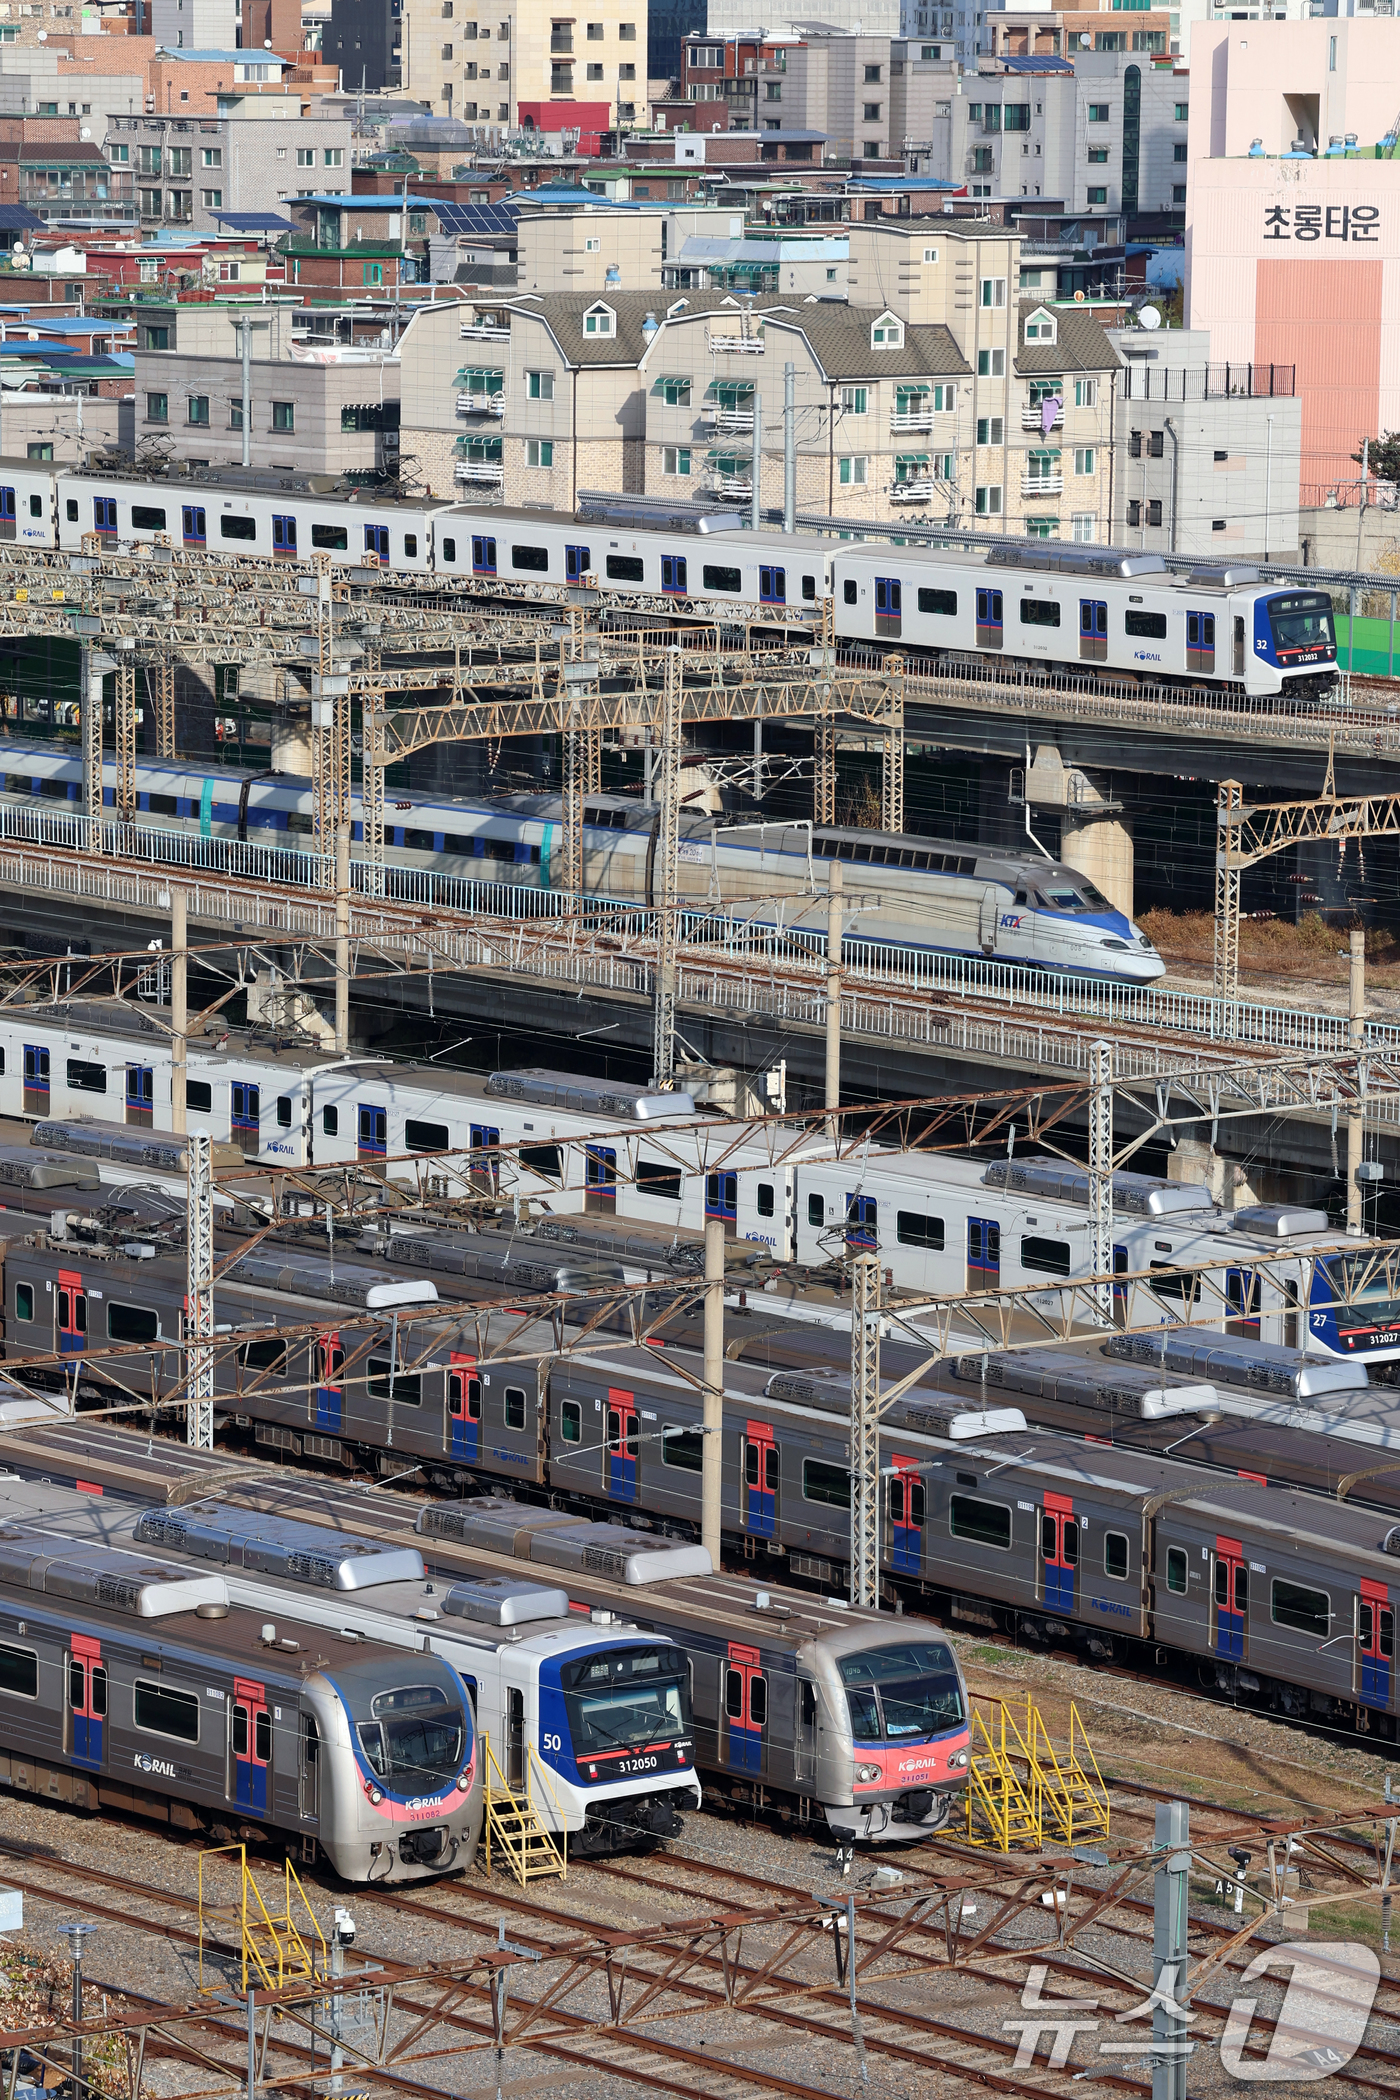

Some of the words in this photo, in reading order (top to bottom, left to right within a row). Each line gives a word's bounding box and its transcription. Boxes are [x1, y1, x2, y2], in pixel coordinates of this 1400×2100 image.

[1263, 205, 1380, 242] 초롱타운
[23, 528, 46, 538] KORAIL
[1256, 640, 1267, 650] 32
[1134, 650, 1162, 662] KORAIL
[1297, 653, 1318, 662] 312032
[1000, 914, 1028, 928] KTX
[267, 1141, 295, 1155] KORAIL
[746, 1231, 777, 1247] KORAIL
[1313, 1313, 1327, 1327] 27
[1370, 1332, 1398, 1345] 312027
[493, 1446, 529, 1465] KORAIL
[1083, 1519, 1087, 1528] 2
[1091, 1596, 1132, 1618] KORAIL
[543, 1733, 561, 1751] 50
[674, 1741, 693, 1749] KORAIL
[134, 1754, 176, 1778] KORAIL
[619, 1756, 658, 1773] 312050
[898, 1757, 937, 1772] KORAIL
[901, 1773, 929, 1783] 311051
[405, 1797, 443, 1811] KORAIL
[410, 1810, 441, 1821] 311082
